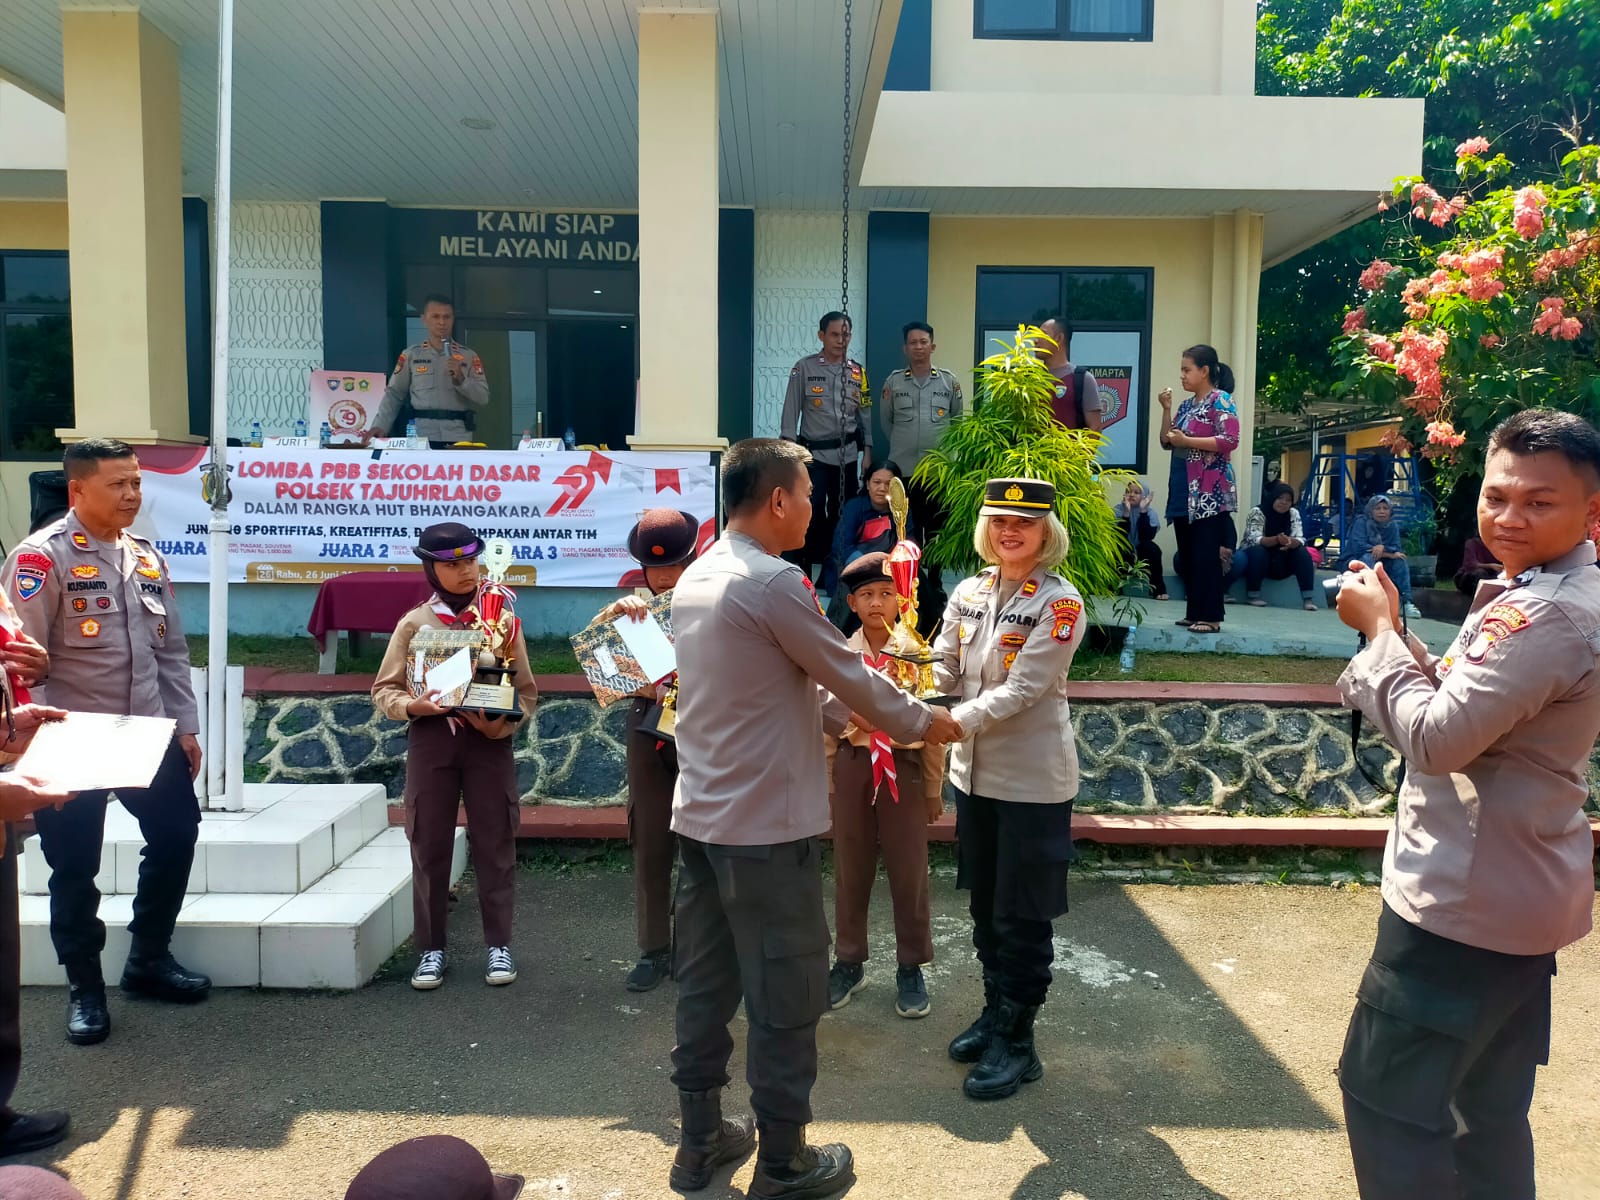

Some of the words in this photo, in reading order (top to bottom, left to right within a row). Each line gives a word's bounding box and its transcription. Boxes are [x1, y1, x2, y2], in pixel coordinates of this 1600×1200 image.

[477, 211, 546, 233] KAMI
[555, 214, 615, 235] SIAP
[440, 235, 568, 259] MELAYANI
[1089, 368, 1125, 378] AMAPTA
[275, 437, 300, 446] JURI
[387, 440, 405, 448] JUR
[527, 440, 545, 449] JURI
[238, 461, 314, 478] LOMBA
[321, 462, 361, 479] PBB
[366, 463, 464, 481] SEKOLAH
[470, 464, 541, 482] DASAR
[275, 482, 355, 500] POLSEK
[361, 483, 502, 502] TAJUHRLANG
[244, 502, 298, 515] DALAM
[303, 503, 371, 516] RANGKA
[376, 504, 405, 516] HUT
[410, 504, 541, 518] BHAYANGAKARA
[244, 525, 326, 537] SPORTIFITAS,
[330, 526, 411, 539] KREATIFITAS,
[532, 528, 573, 540] ANTAR
[575, 529, 597, 540] TIM
[318, 543, 375, 558] JUARA
[379, 544, 389, 558] 2
[512, 545, 544, 560] ARA
[547, 545, 558, 560] 3
[276, 570, 303, 579] Rabu,
[305, 570, 318, 579] 26
